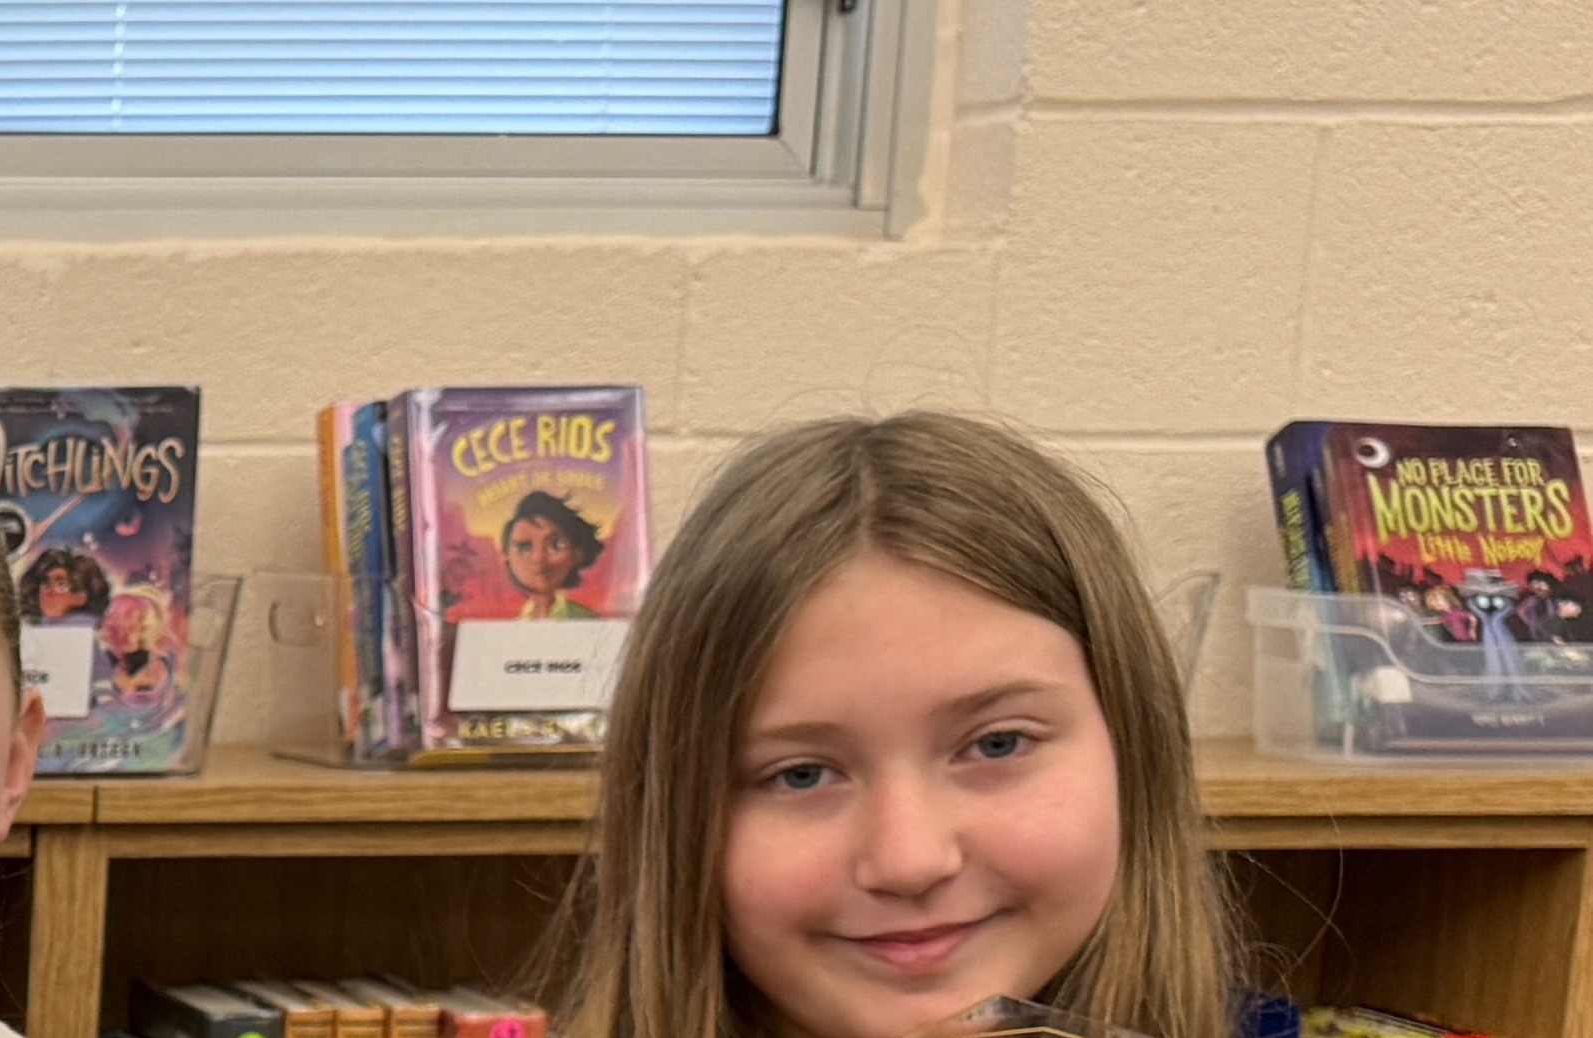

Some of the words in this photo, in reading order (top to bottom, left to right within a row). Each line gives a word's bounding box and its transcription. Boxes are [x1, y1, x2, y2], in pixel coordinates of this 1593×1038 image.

[452, 417, 530, 477] CECE
[536, 414, 616, 463] RIOS
[1395, 457, 1428, 486] NO
[1428, 457, 1497, 486] PLACE
[1501, 456, 1546, 486] FOR
[1367, 473, 1573, 545] MONSTERS
[503, 659, 542, 673] CECE
